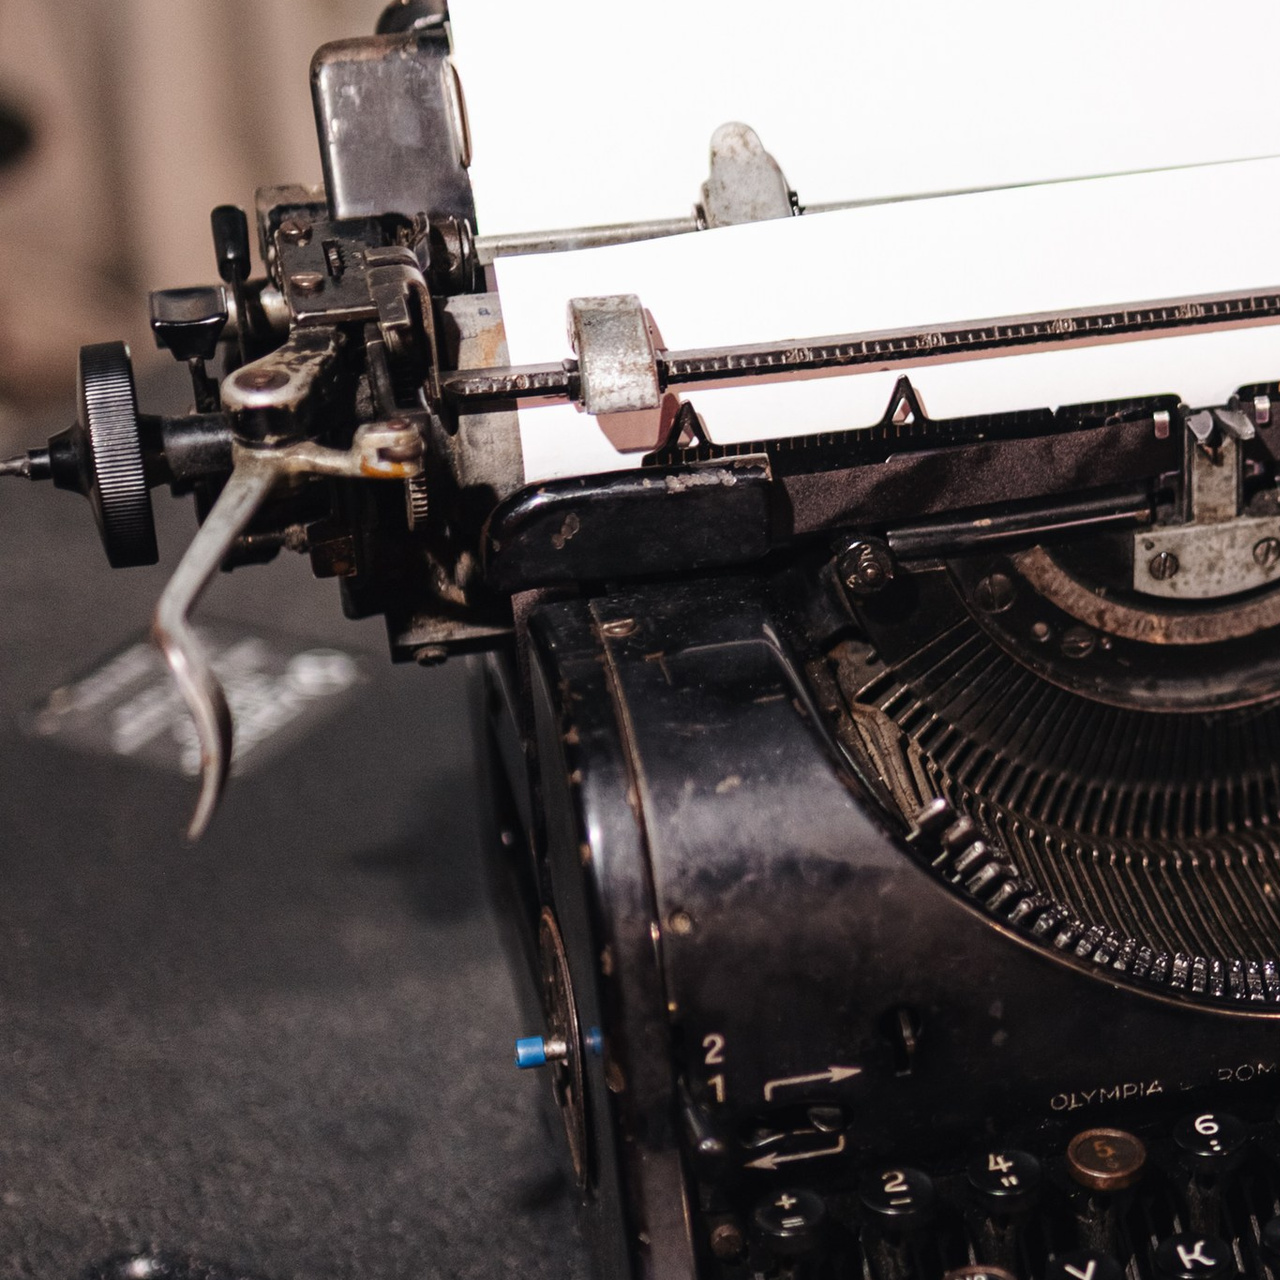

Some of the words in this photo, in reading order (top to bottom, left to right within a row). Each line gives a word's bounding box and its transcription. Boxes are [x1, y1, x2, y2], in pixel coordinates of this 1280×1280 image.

[702, 1033, 725, 1065] 2
[708, 1074, 724, 1102] 1
[1050, 1079, 1163, 1111] OLYMPIA
[1194, 1114, 1219, 1135] 6
[988, 1154, 1013, 1173] 4
[882, 1171, 908, 1193] 2
[1176, 1240, 1216, 1269] К
